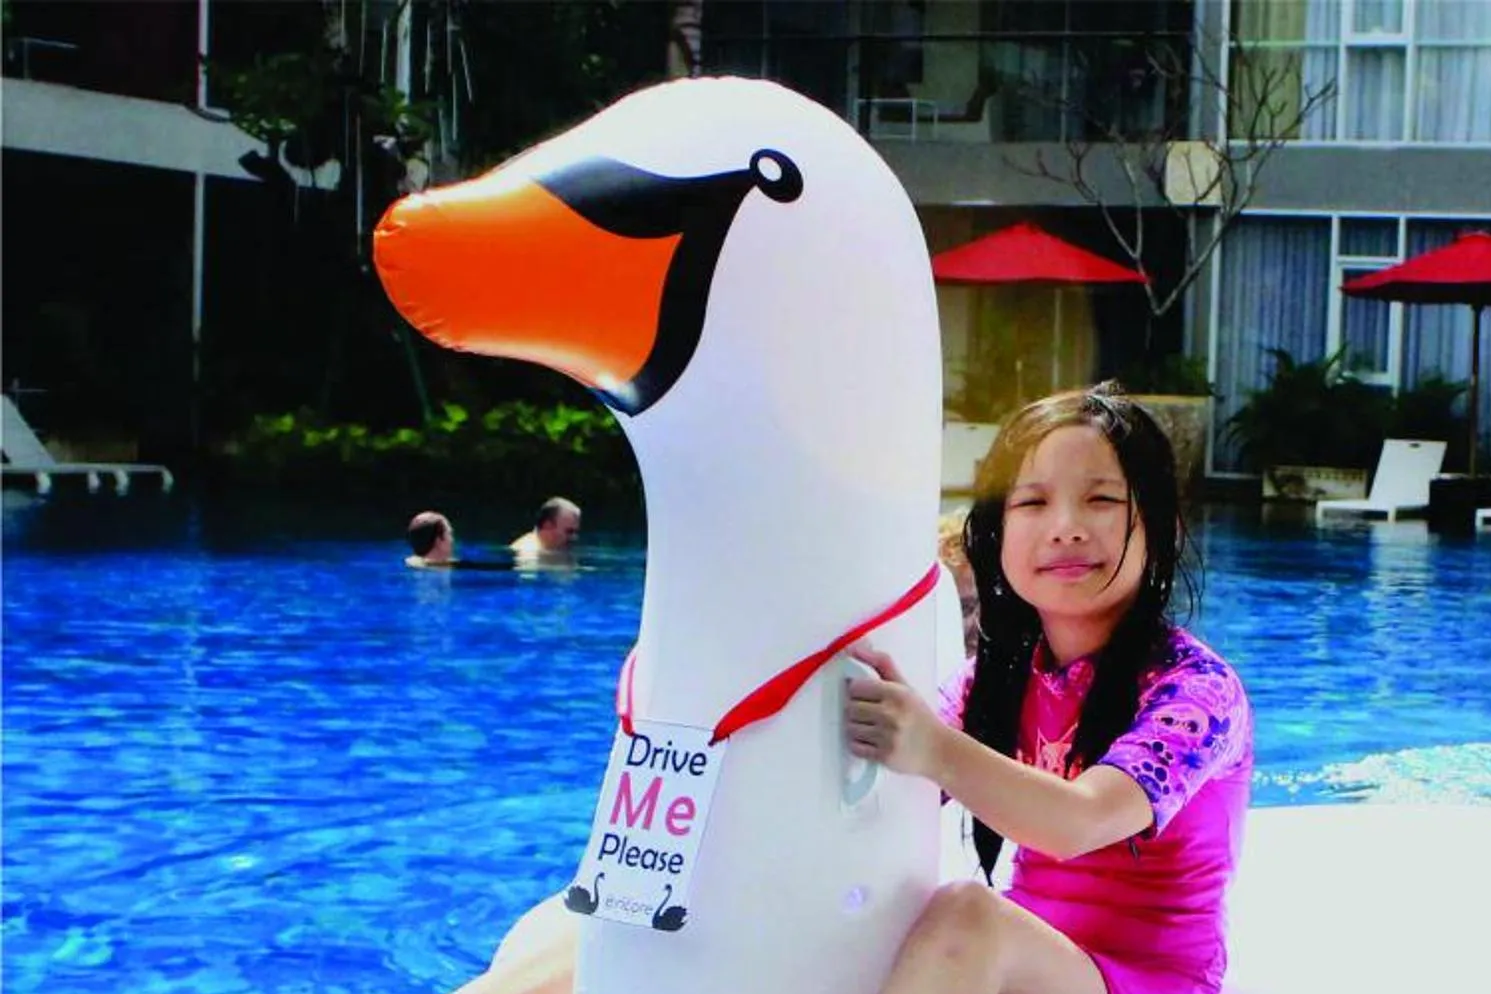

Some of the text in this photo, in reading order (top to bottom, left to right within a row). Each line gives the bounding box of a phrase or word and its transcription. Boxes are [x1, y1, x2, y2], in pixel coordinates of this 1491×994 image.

[627, 734, 707, 775] Drive
[610, 772, 695, 835] Me
[598, 833, 684, 874] Please
